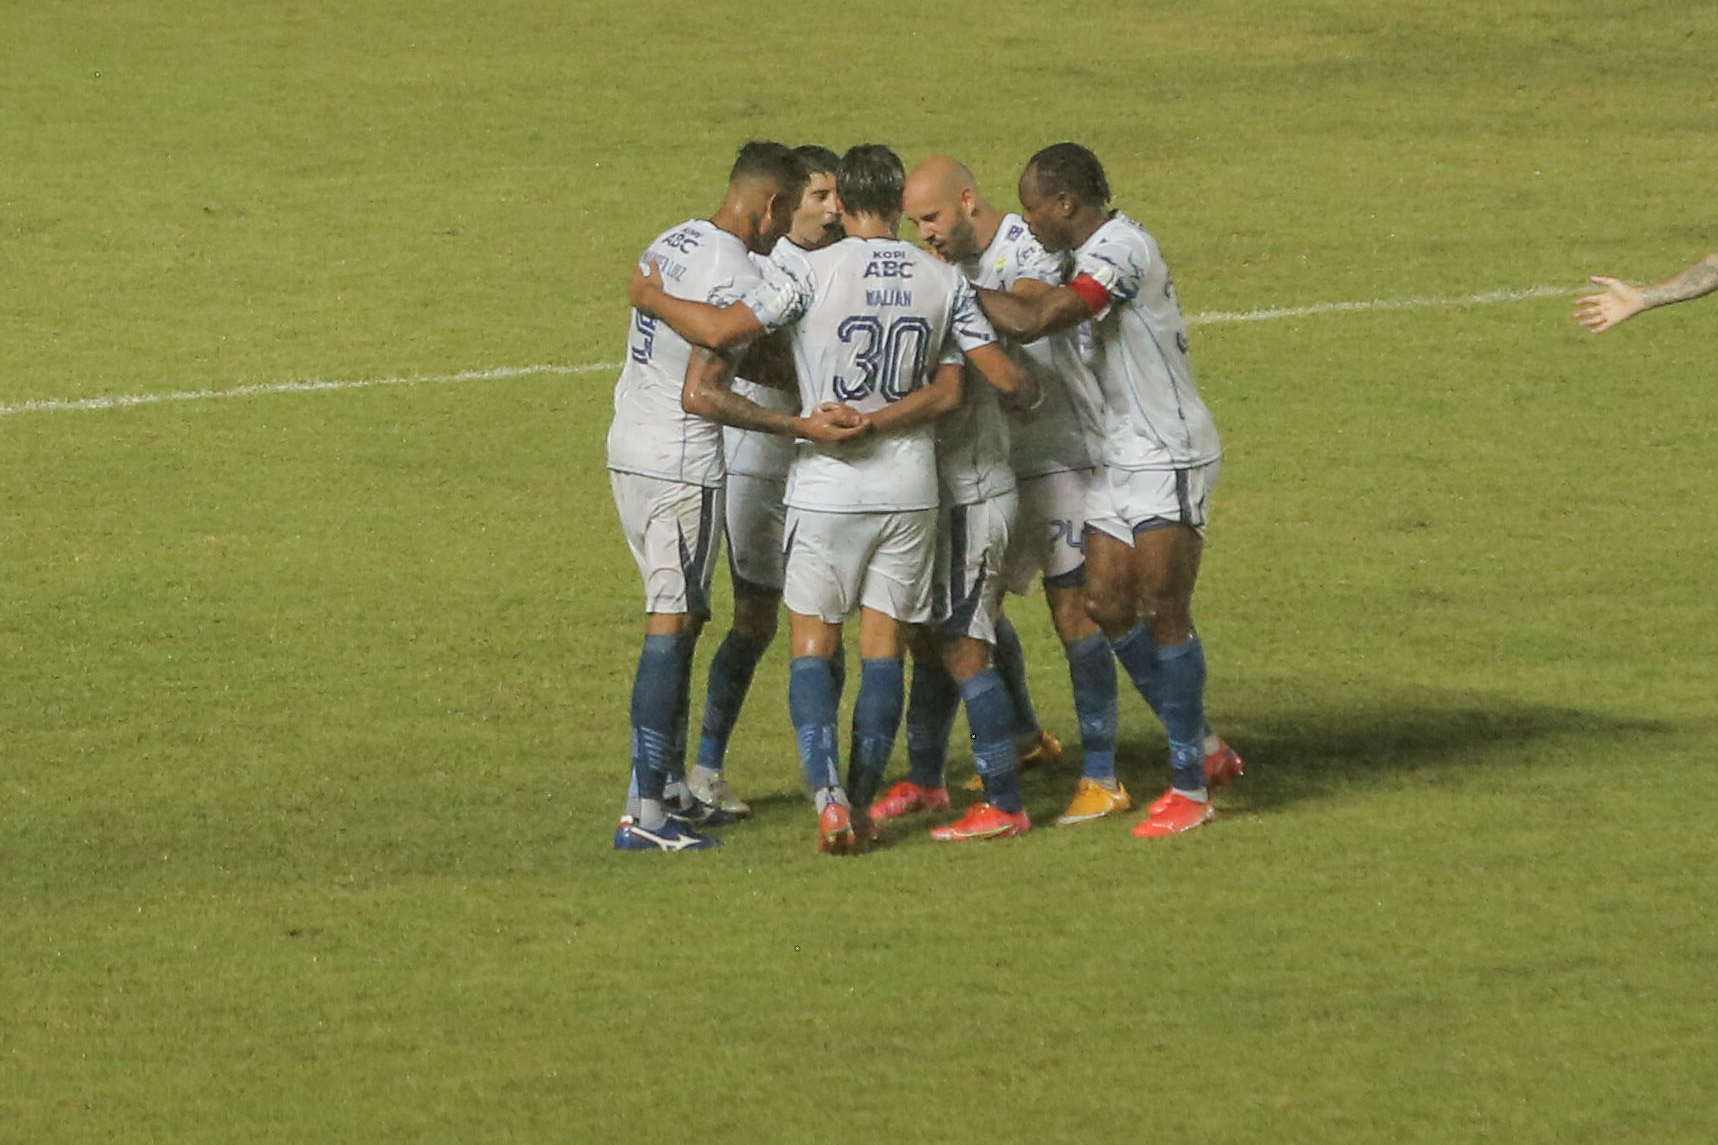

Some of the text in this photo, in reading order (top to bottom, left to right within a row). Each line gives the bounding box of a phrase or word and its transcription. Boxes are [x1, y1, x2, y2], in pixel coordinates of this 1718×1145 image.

[661, 232, 699, 254] ABC
[873, 251, 906, 259] KOPI
[863, 260, 914, 279] ABC
[833, 316, 932, 403] 30
